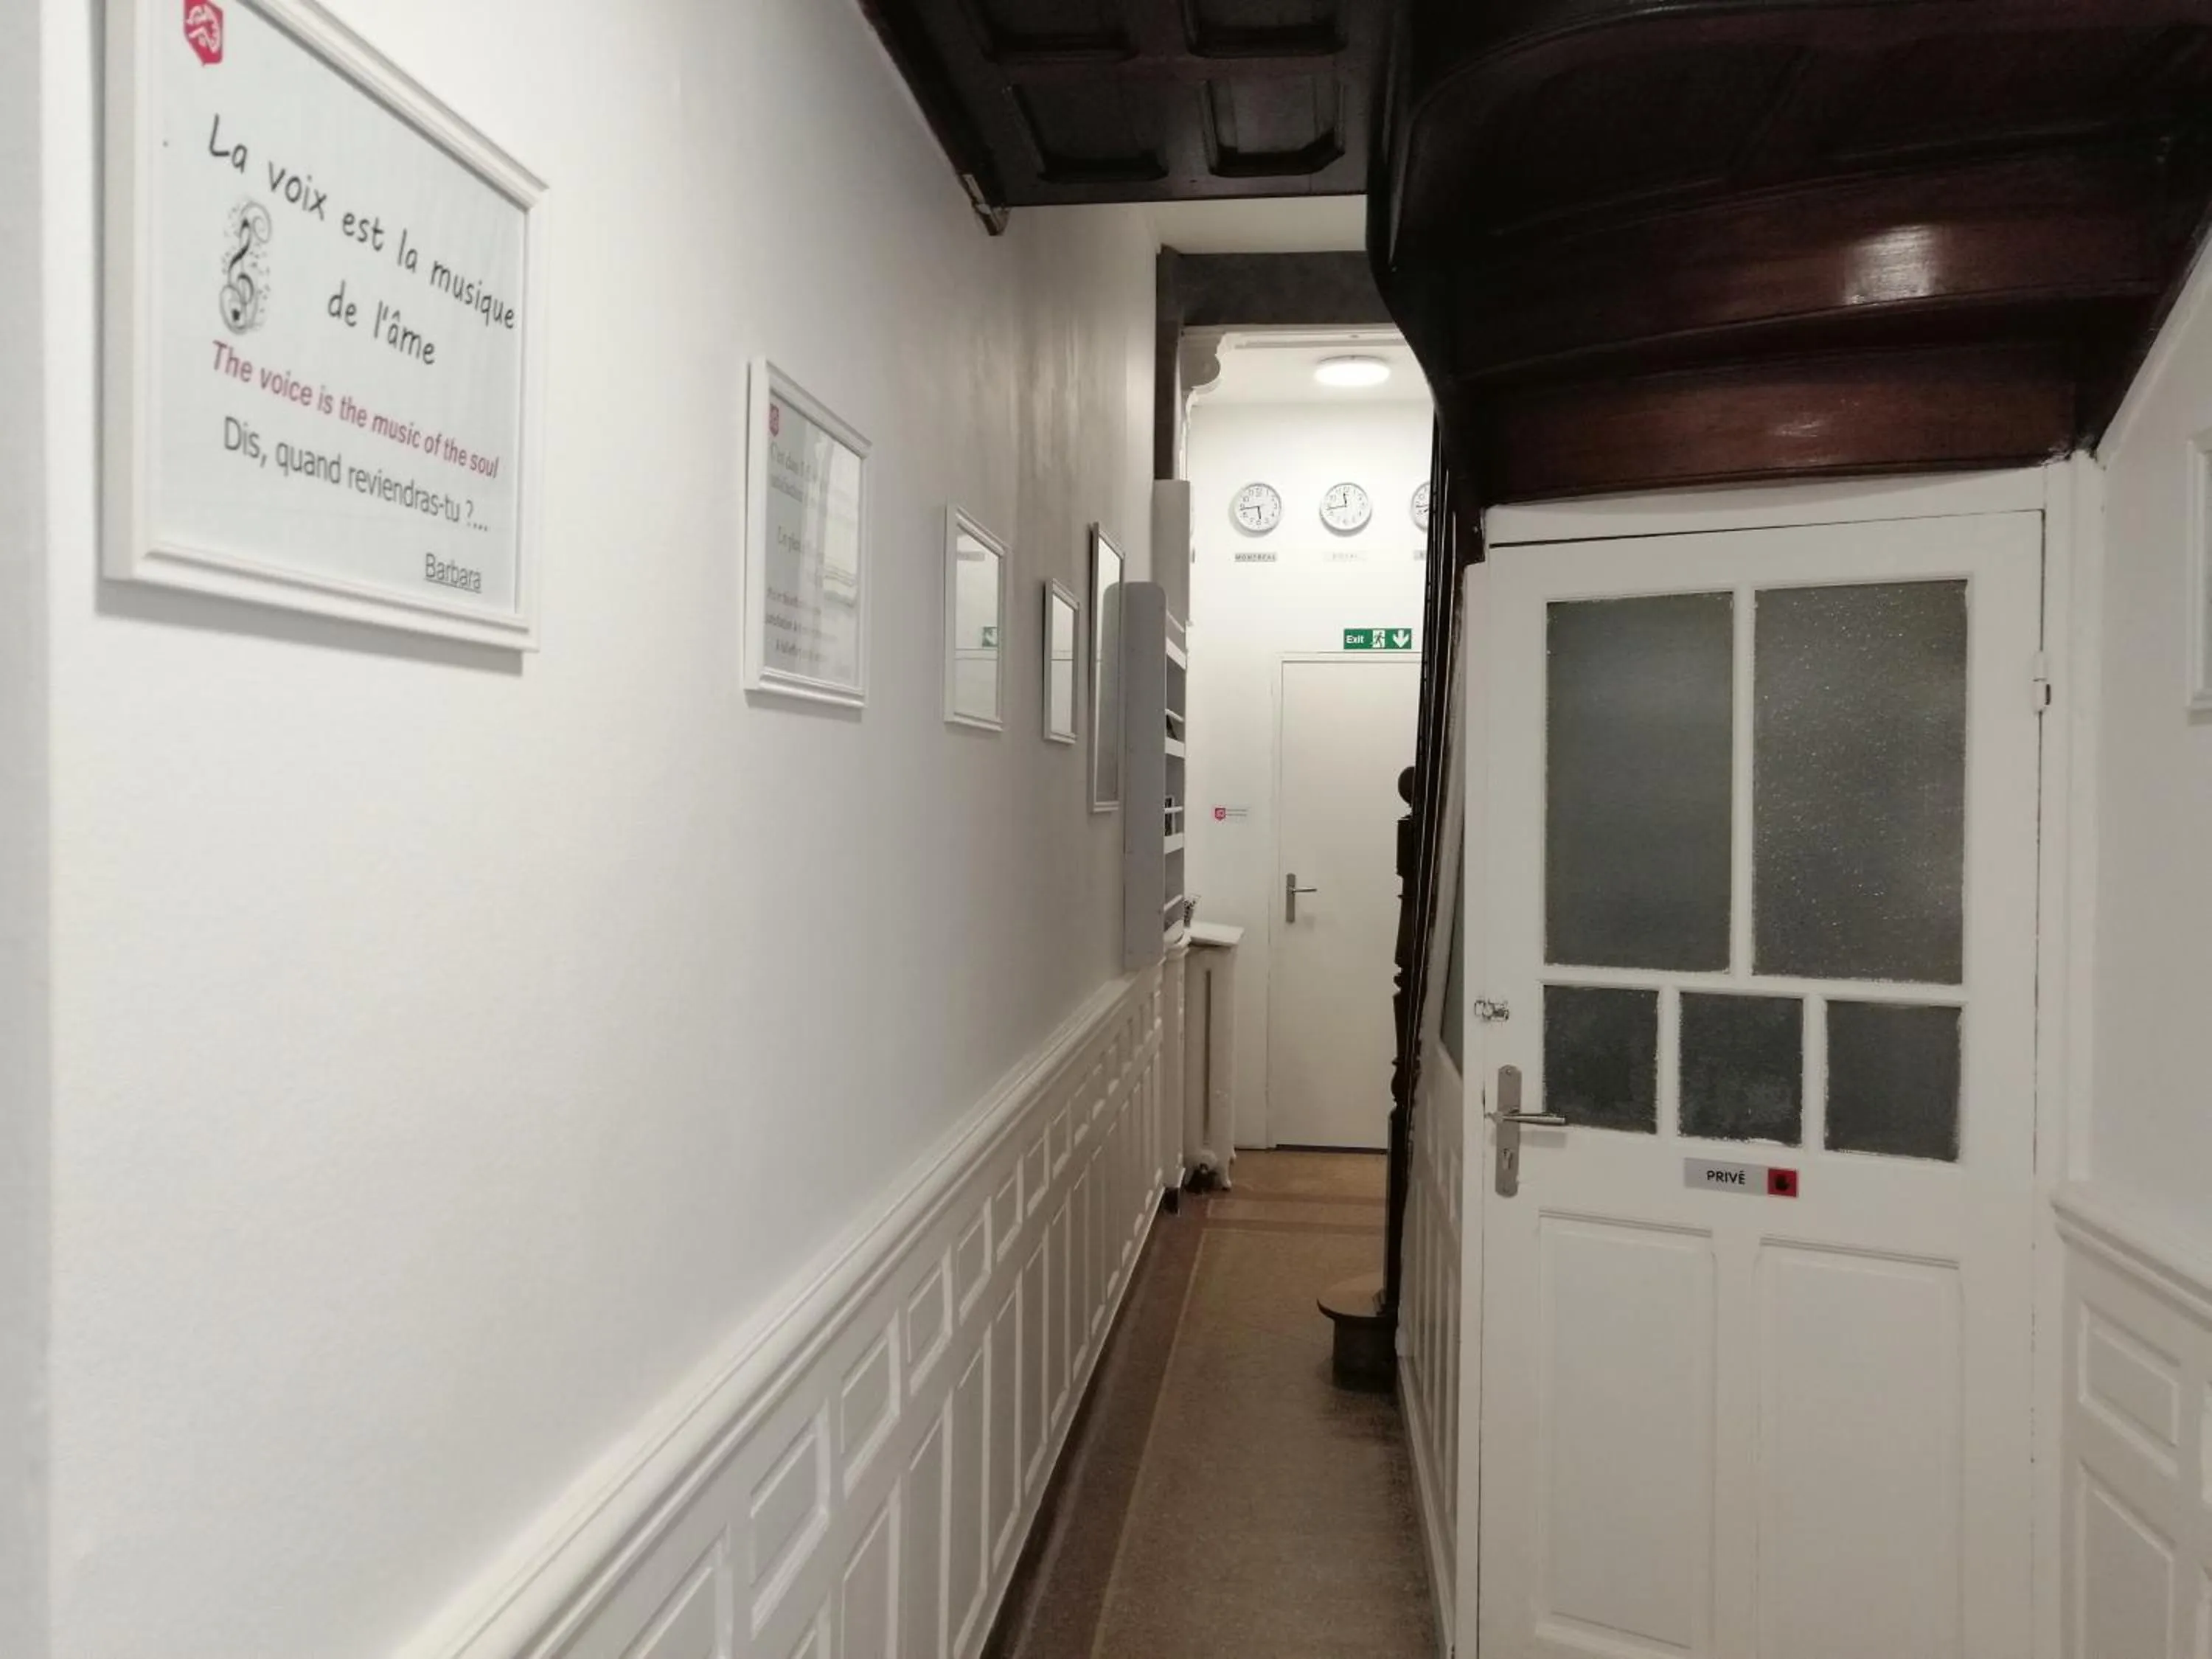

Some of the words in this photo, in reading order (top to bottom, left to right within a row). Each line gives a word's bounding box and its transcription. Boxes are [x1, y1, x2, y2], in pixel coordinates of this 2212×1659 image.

[209, 113, 248, 173] La
[268, 161, 327, 220] voix
[342, 212, 385, 251] est
[397, 228, 418, 273] la
[431, 260, 515, 329] musique
[327, 279, 357, 327] de
[374, 299, 435, 365] l'âme
[212, 340, 252, 383] The
[260, 368, 313, 406] voice
[317, 384, 334, 414] is
[339, 395, 367, 428] the
[371, 414, 421, 448] music
[424, 433, 442, 456] of
[443, 438, 467, 467] the
[470, 454, 499, 479] soul
[224, 415, 267, 468] Dis,
[276, 442, 341, 484] quand
[347, 465, 461, 523] reviendras-tu
[425, 552, 481, 591] Barbara
[1346, 635, 1364, 644] Exit
[1706, 1169, 1746, 1185] PRIVÉ
